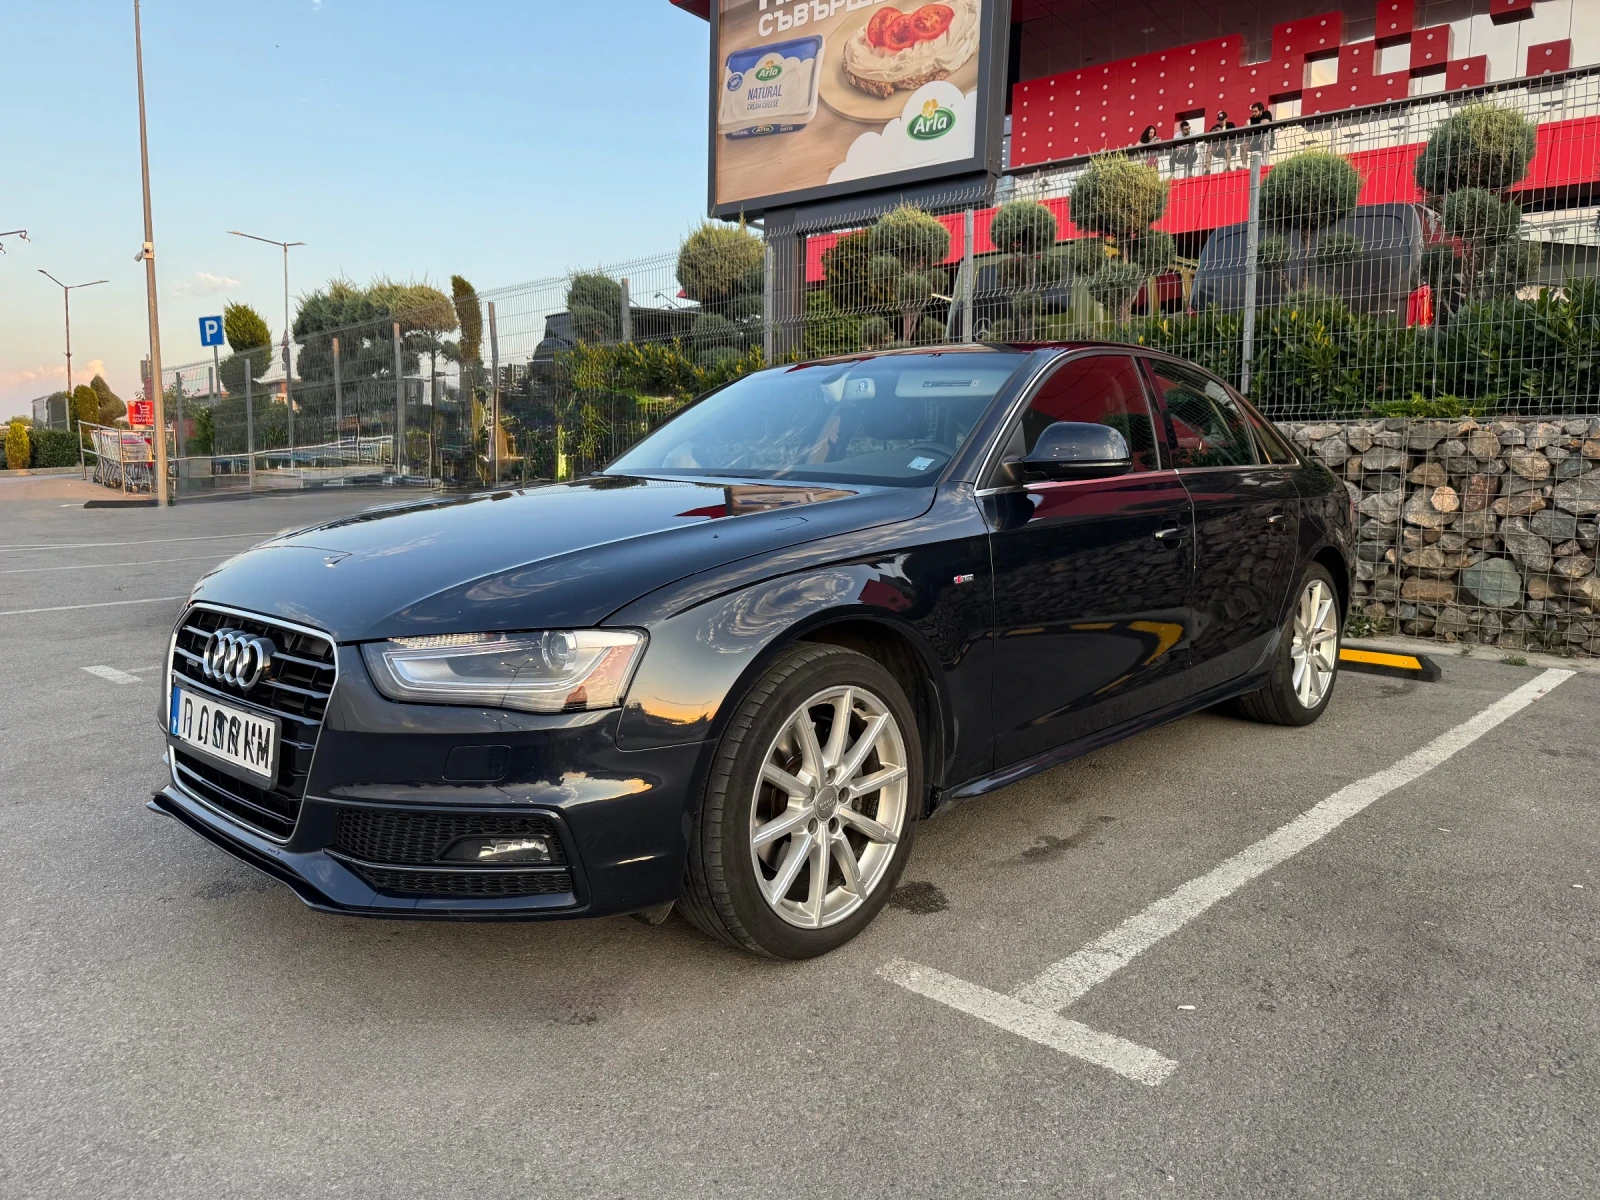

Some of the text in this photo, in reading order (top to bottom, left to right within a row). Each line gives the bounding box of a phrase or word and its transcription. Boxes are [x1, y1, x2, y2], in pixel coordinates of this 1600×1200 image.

[758, 0, 888, 36] СЪВЪР
[758, 67, 778, 78] Arla
[747, 84, 782, 100] NATURAL
[747, 100, 779, 110] CREAM CHEESE
[913, 113, 947, 134] Arla
[205, 320, 218, 342] P
